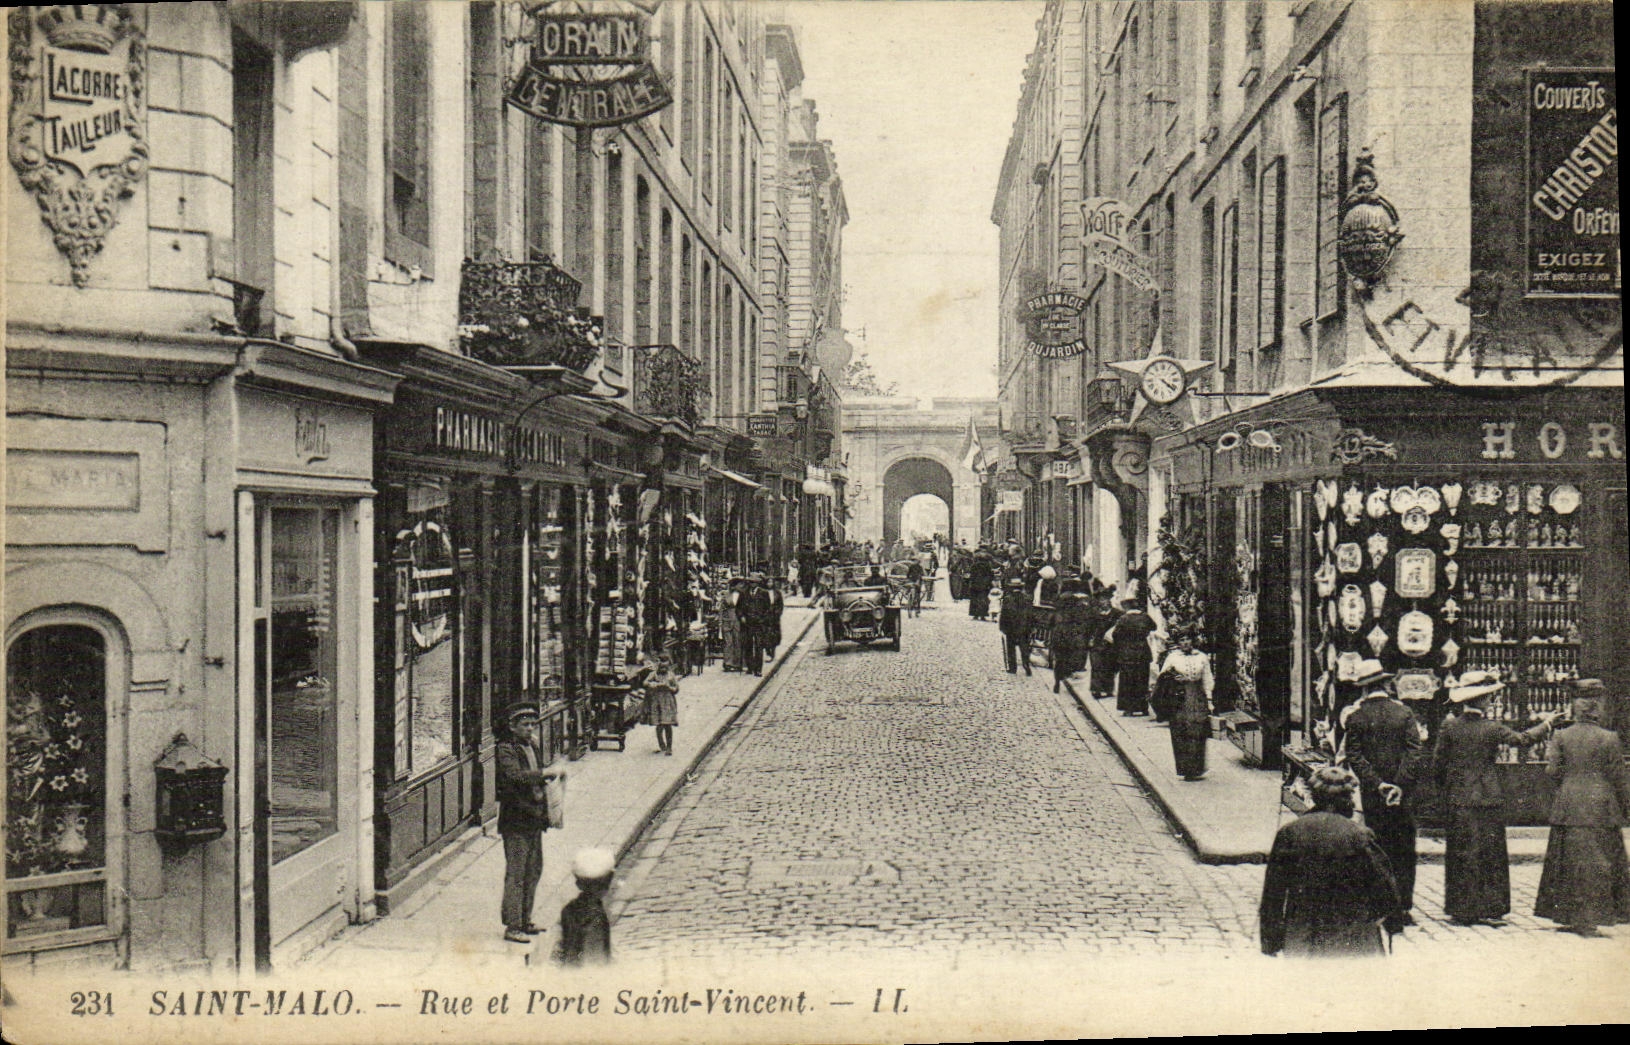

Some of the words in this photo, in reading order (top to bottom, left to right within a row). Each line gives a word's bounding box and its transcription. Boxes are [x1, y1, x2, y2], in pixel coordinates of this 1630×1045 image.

[48, 53, 121, 104] LACORRE
[43, 110, 121, 154] TAILLEUR
[1538, 253, 1606, 266] EXIGEZ
[1027, 294, 1086, 312] PHARMACIE
[1027, 340, 1085, 357] DUJARDIN
